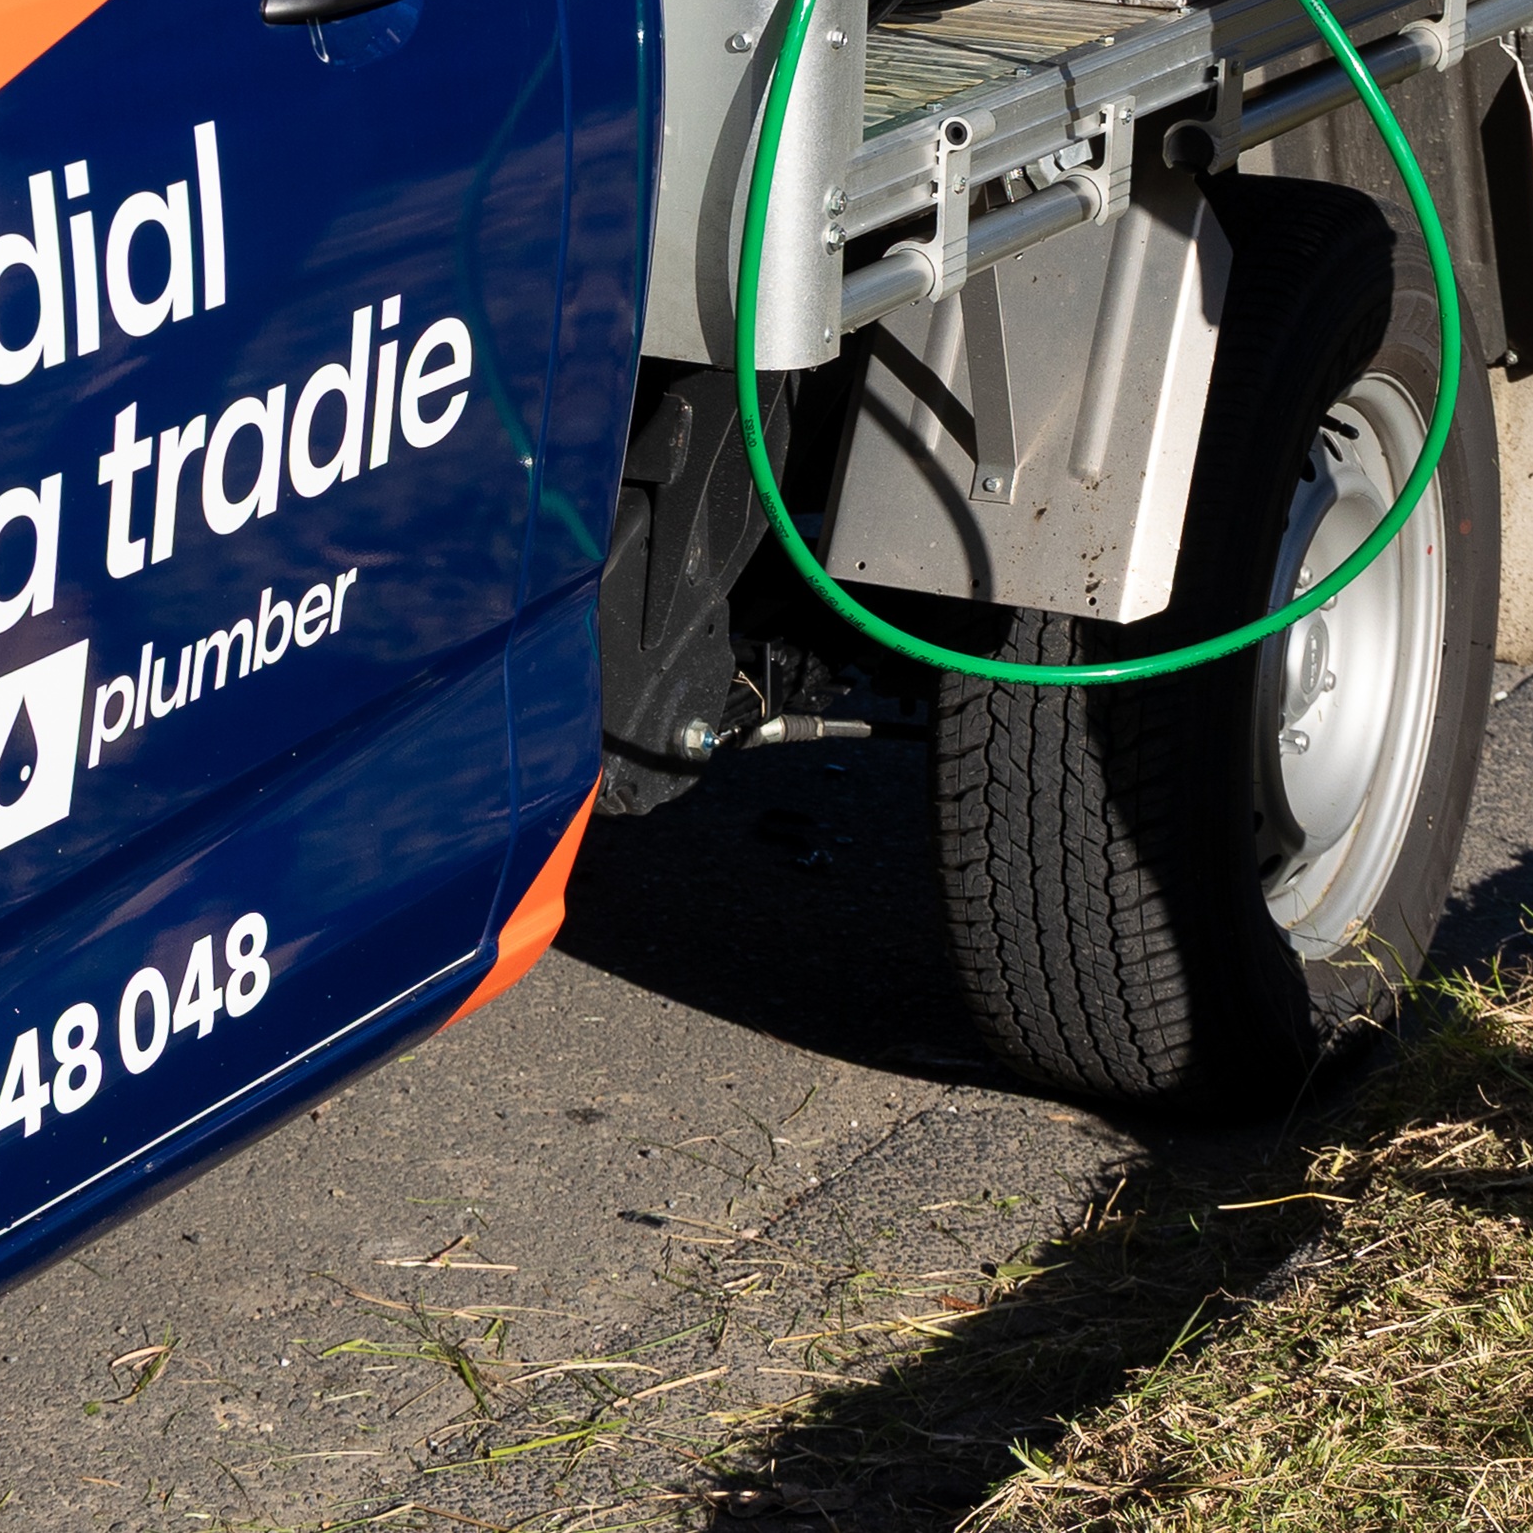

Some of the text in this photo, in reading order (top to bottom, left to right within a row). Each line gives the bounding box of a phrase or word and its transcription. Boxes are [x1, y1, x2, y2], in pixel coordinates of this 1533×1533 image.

[97, 294, 472, 579] tradie
[88, 567, 357, 769] plumber
[118, 911, 271, 1076] 048
